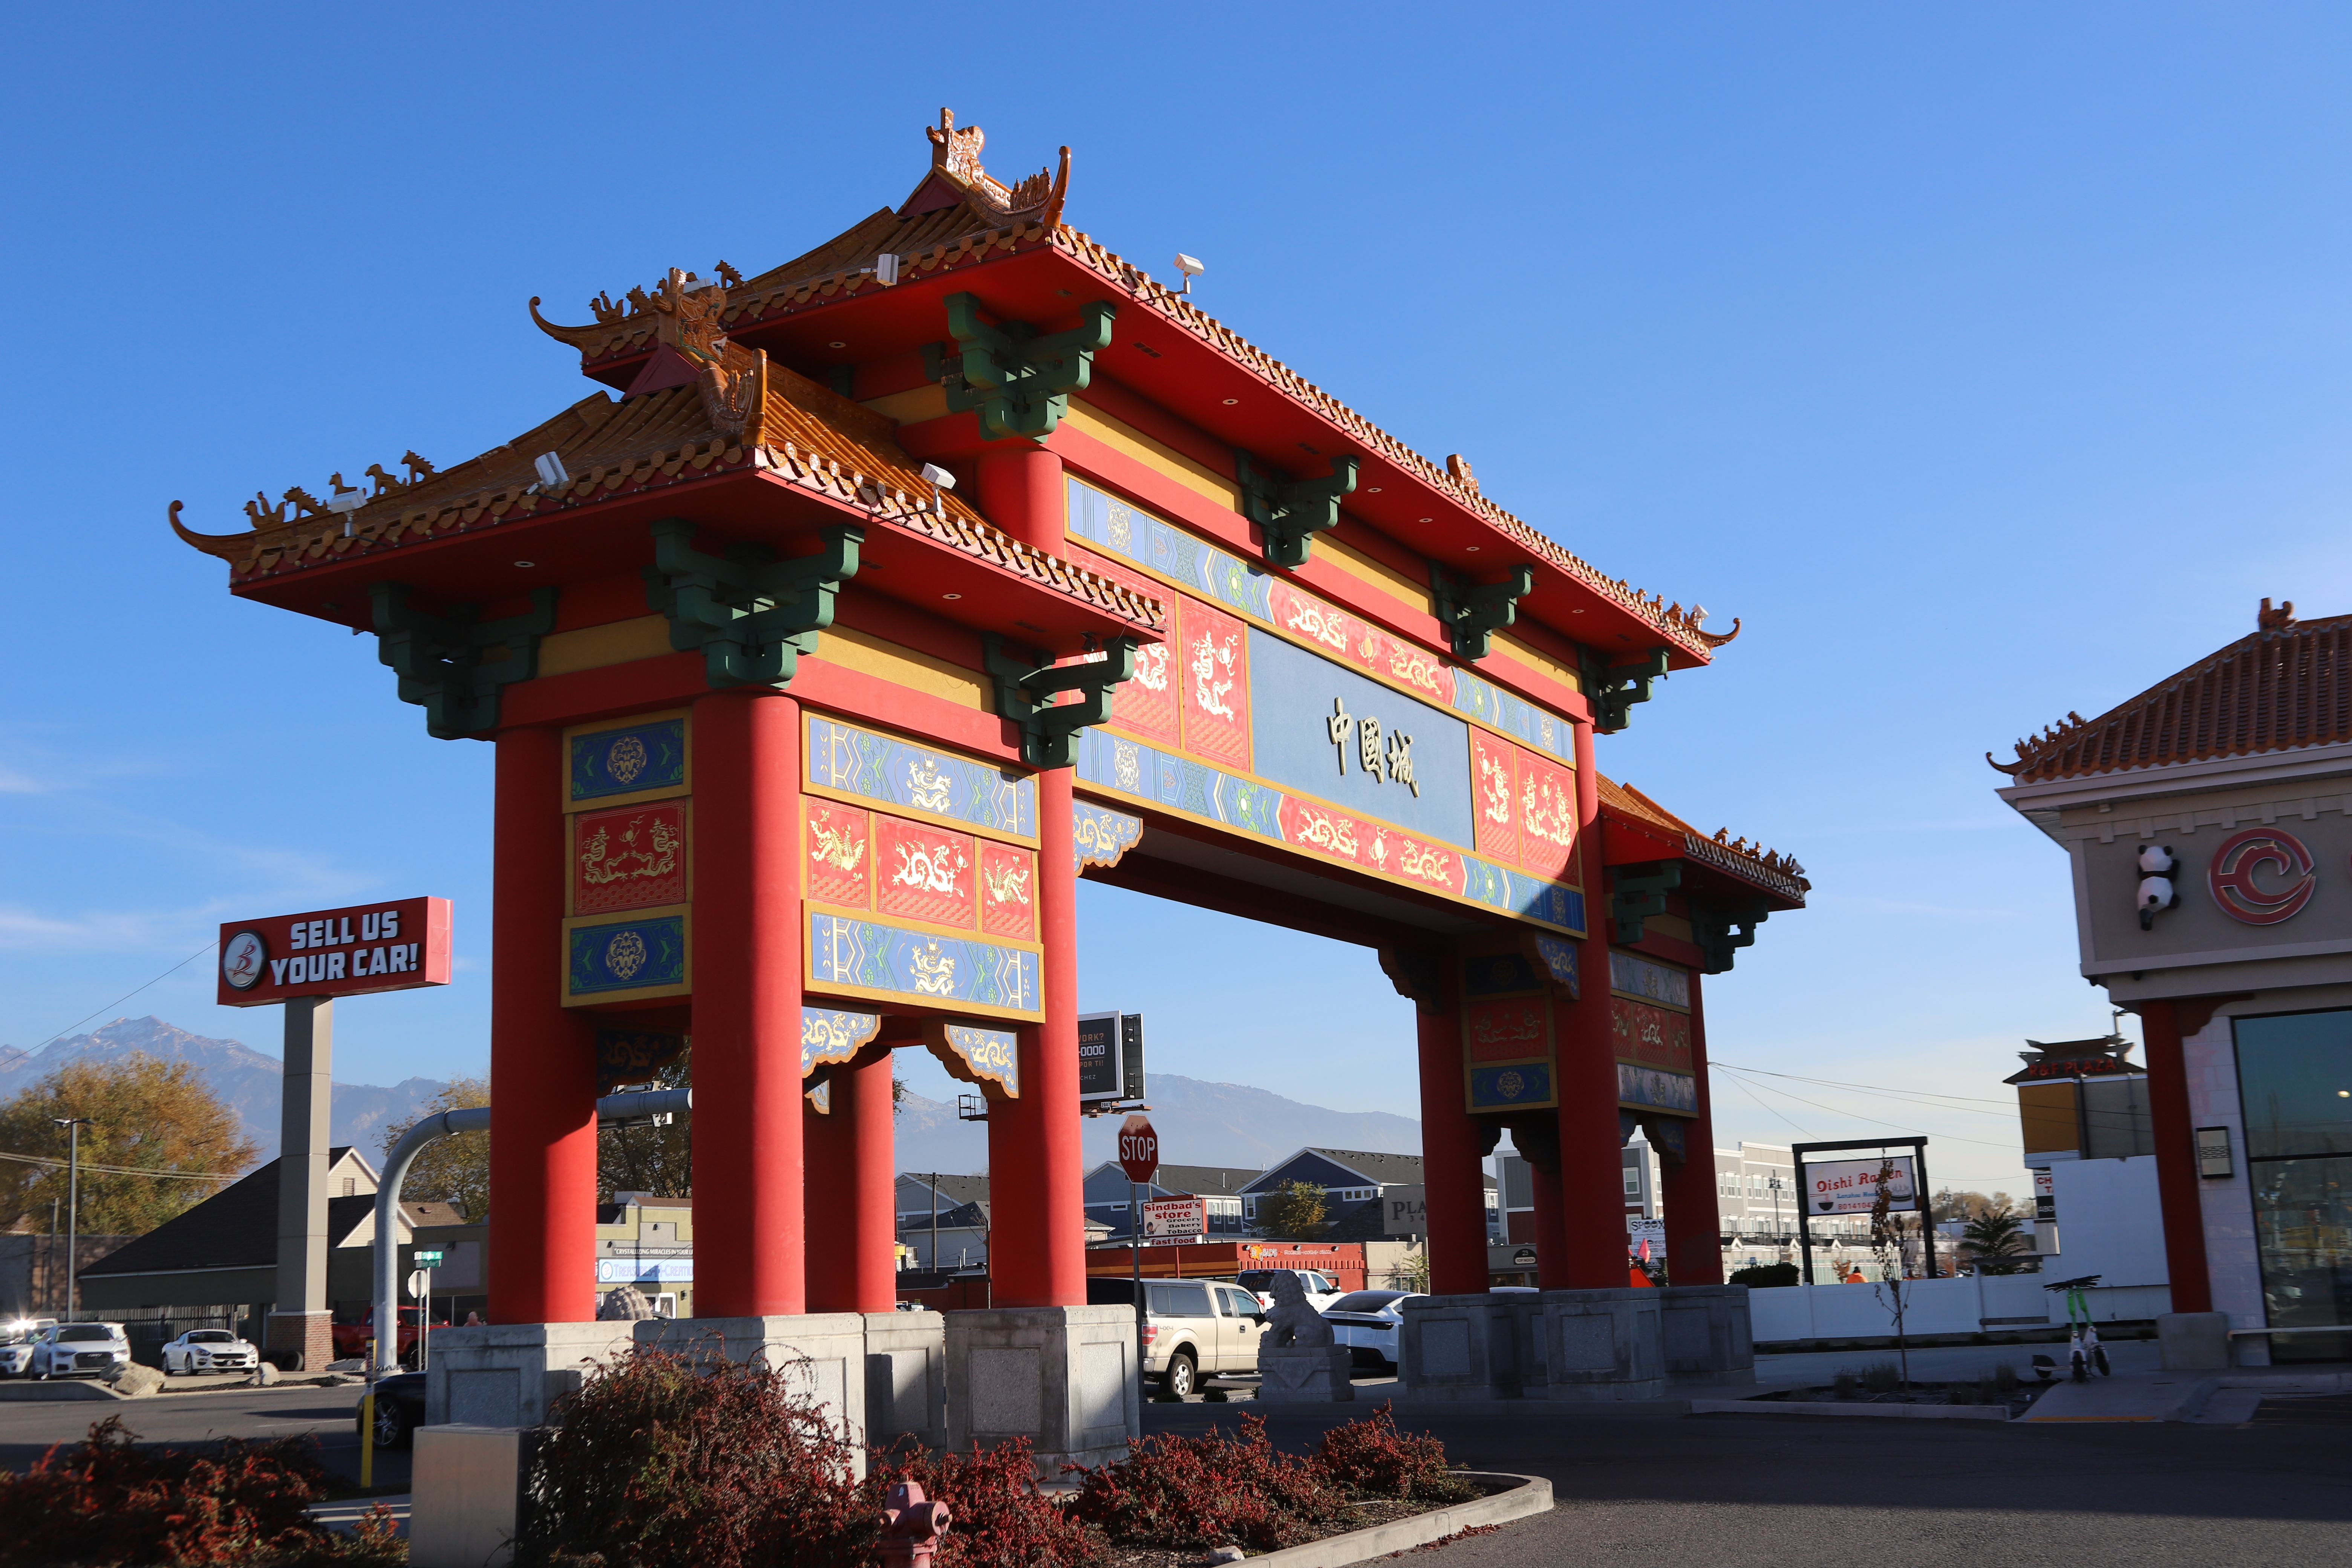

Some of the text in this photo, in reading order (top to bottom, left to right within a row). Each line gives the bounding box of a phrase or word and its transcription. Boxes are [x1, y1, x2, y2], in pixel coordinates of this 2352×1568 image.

[1327, 697, 1420, 798] 中國城
[290, 910, 398, 950] SELL US
[270, 943, 419, 986] YOUR CAR!
[2064, 1058, 2117, 1074] PLAZA
[1122, 1135, 1155, 1161] STOP
[1817, 1170, 1903, 1192] Oishi Raen
[1144, 1201, 1201, 1212] Sindbad's
[1155, 1211, 1191, 1219] store
